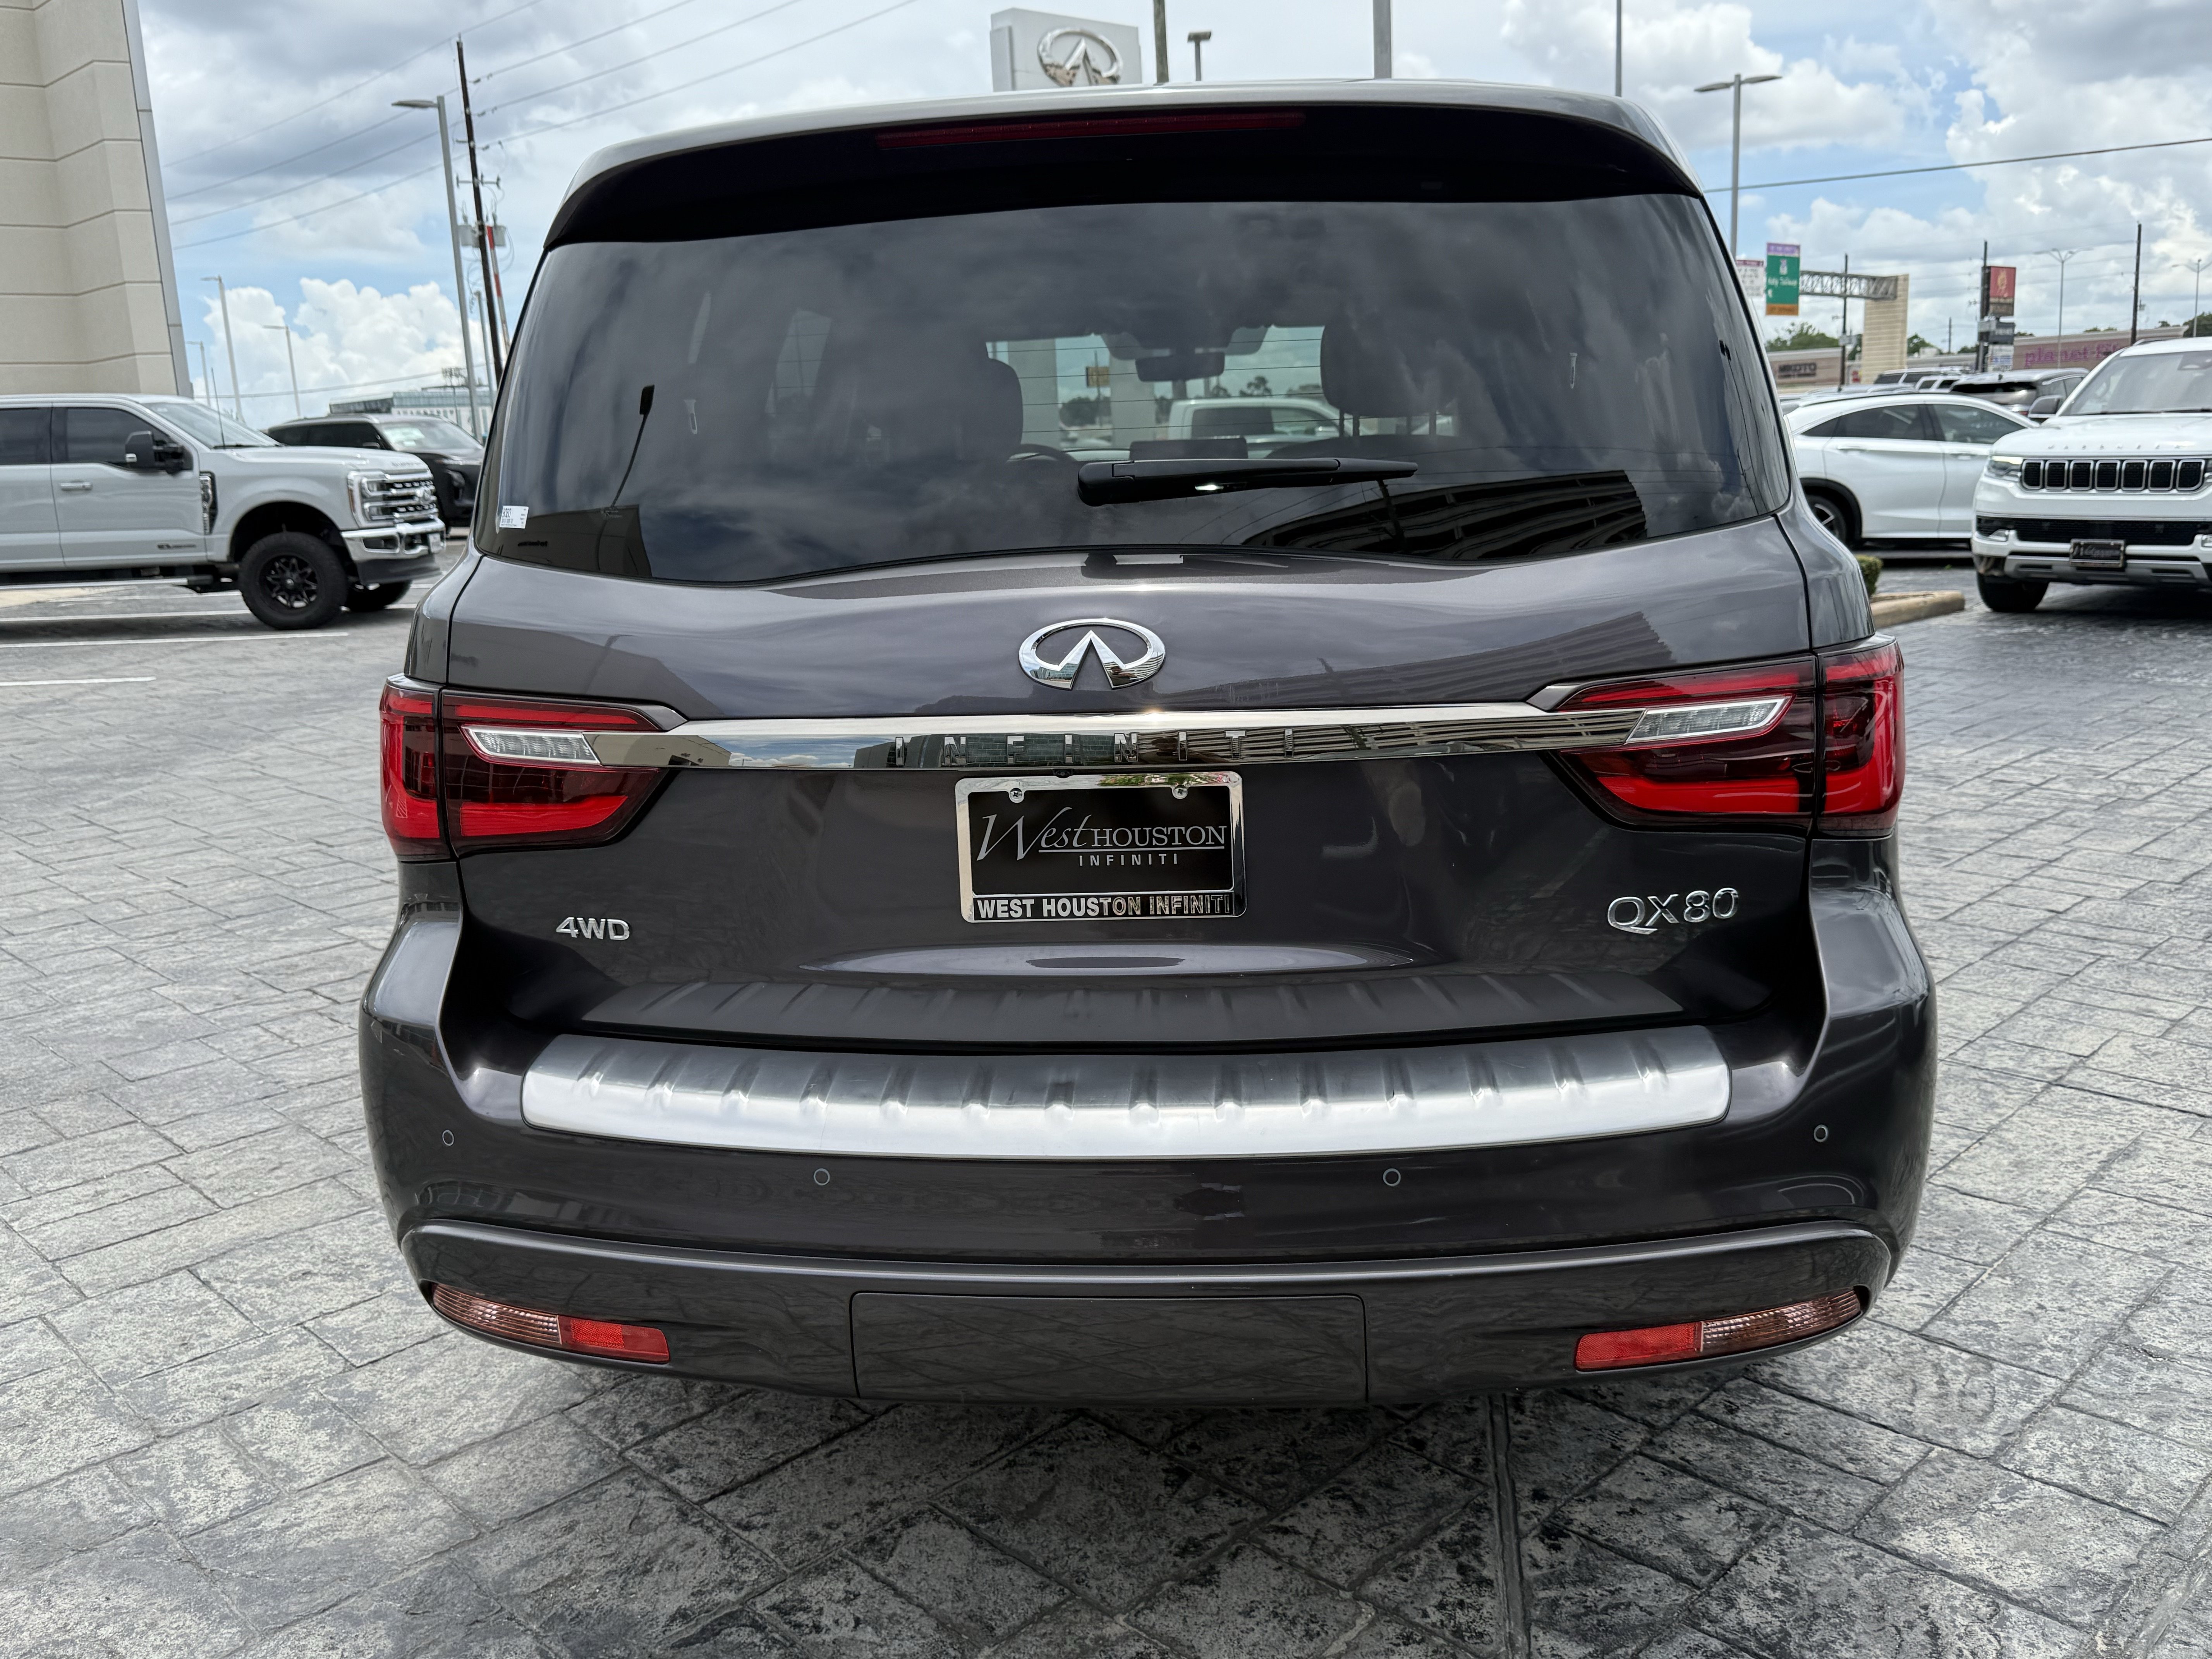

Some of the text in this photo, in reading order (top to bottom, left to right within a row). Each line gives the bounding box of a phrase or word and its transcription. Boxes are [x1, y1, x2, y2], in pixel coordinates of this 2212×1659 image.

[2025, 347, 2088, 367] planet
[895, 728, 1293, 766] INFINITI
[976, 807, 1227, 861] West HOUSTON
[1079, 853, 1177, 866] INFINITI
[977, 895, 1230, 918] WEST HOUSTON INFINITI
[1607, 887, 1739, 935] QX80
[556, 917, 630, 941] 4WD
